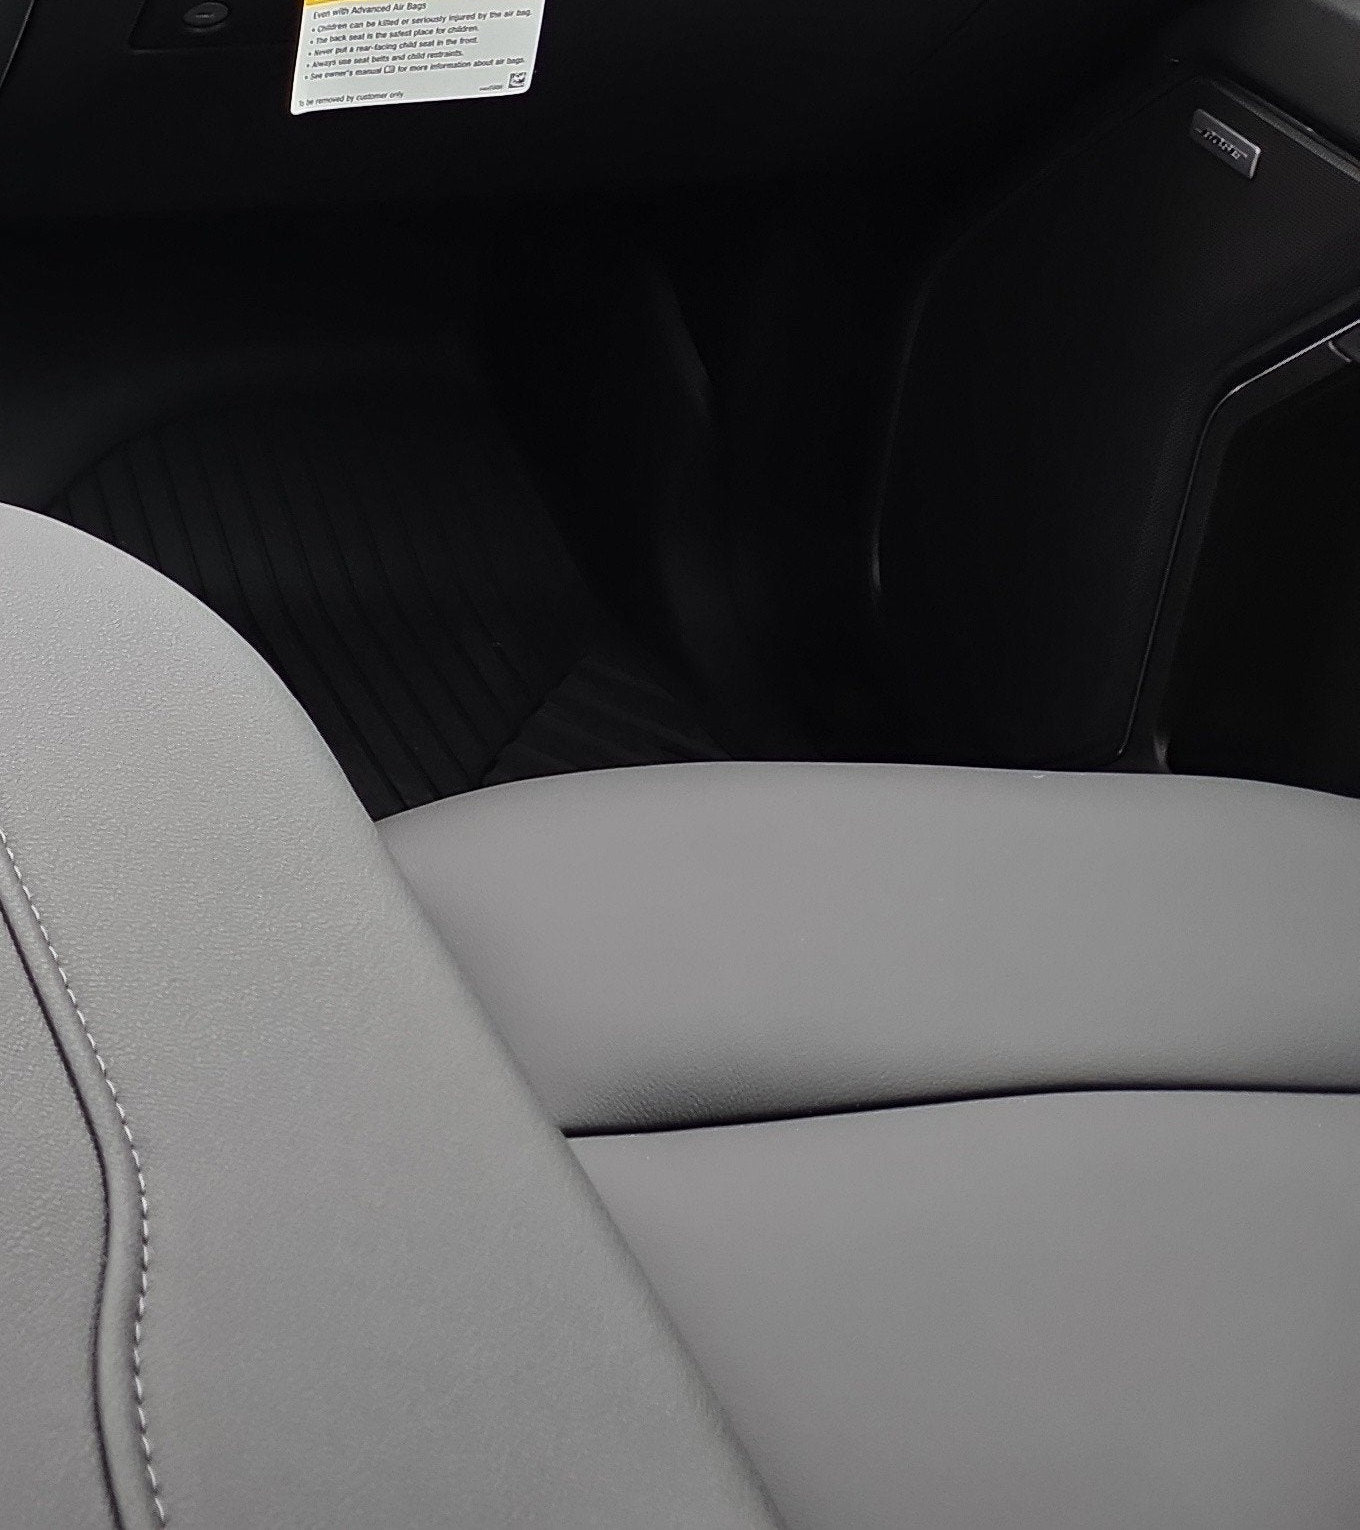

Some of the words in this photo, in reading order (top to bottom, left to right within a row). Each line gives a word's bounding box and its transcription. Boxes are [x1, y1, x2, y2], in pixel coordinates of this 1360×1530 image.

[332, 7, 349, 16] with
[351, 5, 391, 15] Advanced
[392, 3, 405, 12] Air
[406, 1, 427, 12] Bags
[349, 22, 364, 30] can
[489, 10, 502, 19] the
